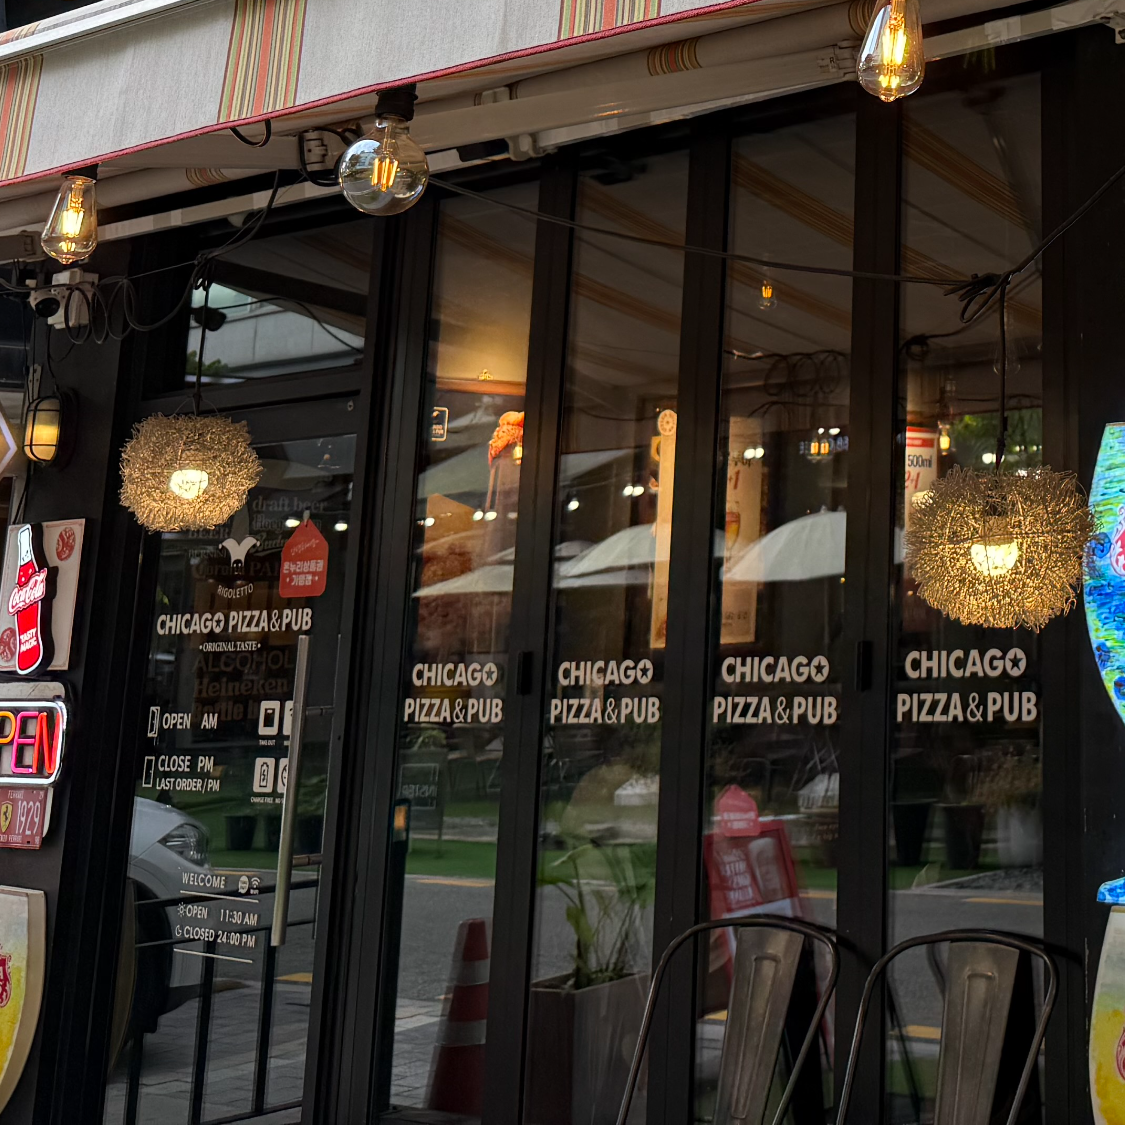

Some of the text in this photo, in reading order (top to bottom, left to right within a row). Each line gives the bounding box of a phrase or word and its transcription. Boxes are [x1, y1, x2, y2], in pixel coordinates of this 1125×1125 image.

[217, 582, 254, 599] RIGOLETTO
[157, 611, 226, 635] CHICAGO
[412, 662, 498, 687] CHICAGO
[558, 658, 654, 686] CHICAGO
[721, 655, 830, 683] CHICAGO
[905, 647, 1027, 679] CHICAGO
[162, 712, 219, 730] OPEN AM
[157, 755, 215, 773] CLOSE PM
[156, 777, 175, 791] LAST
[16, 800, 41, 835] 1929
[182, 872, 226, 889] WELCOME
[186, 904, 258, 927] OPEN 11:30 AM
[184, 926, 256, 949] CLOSED 24:00 PM
